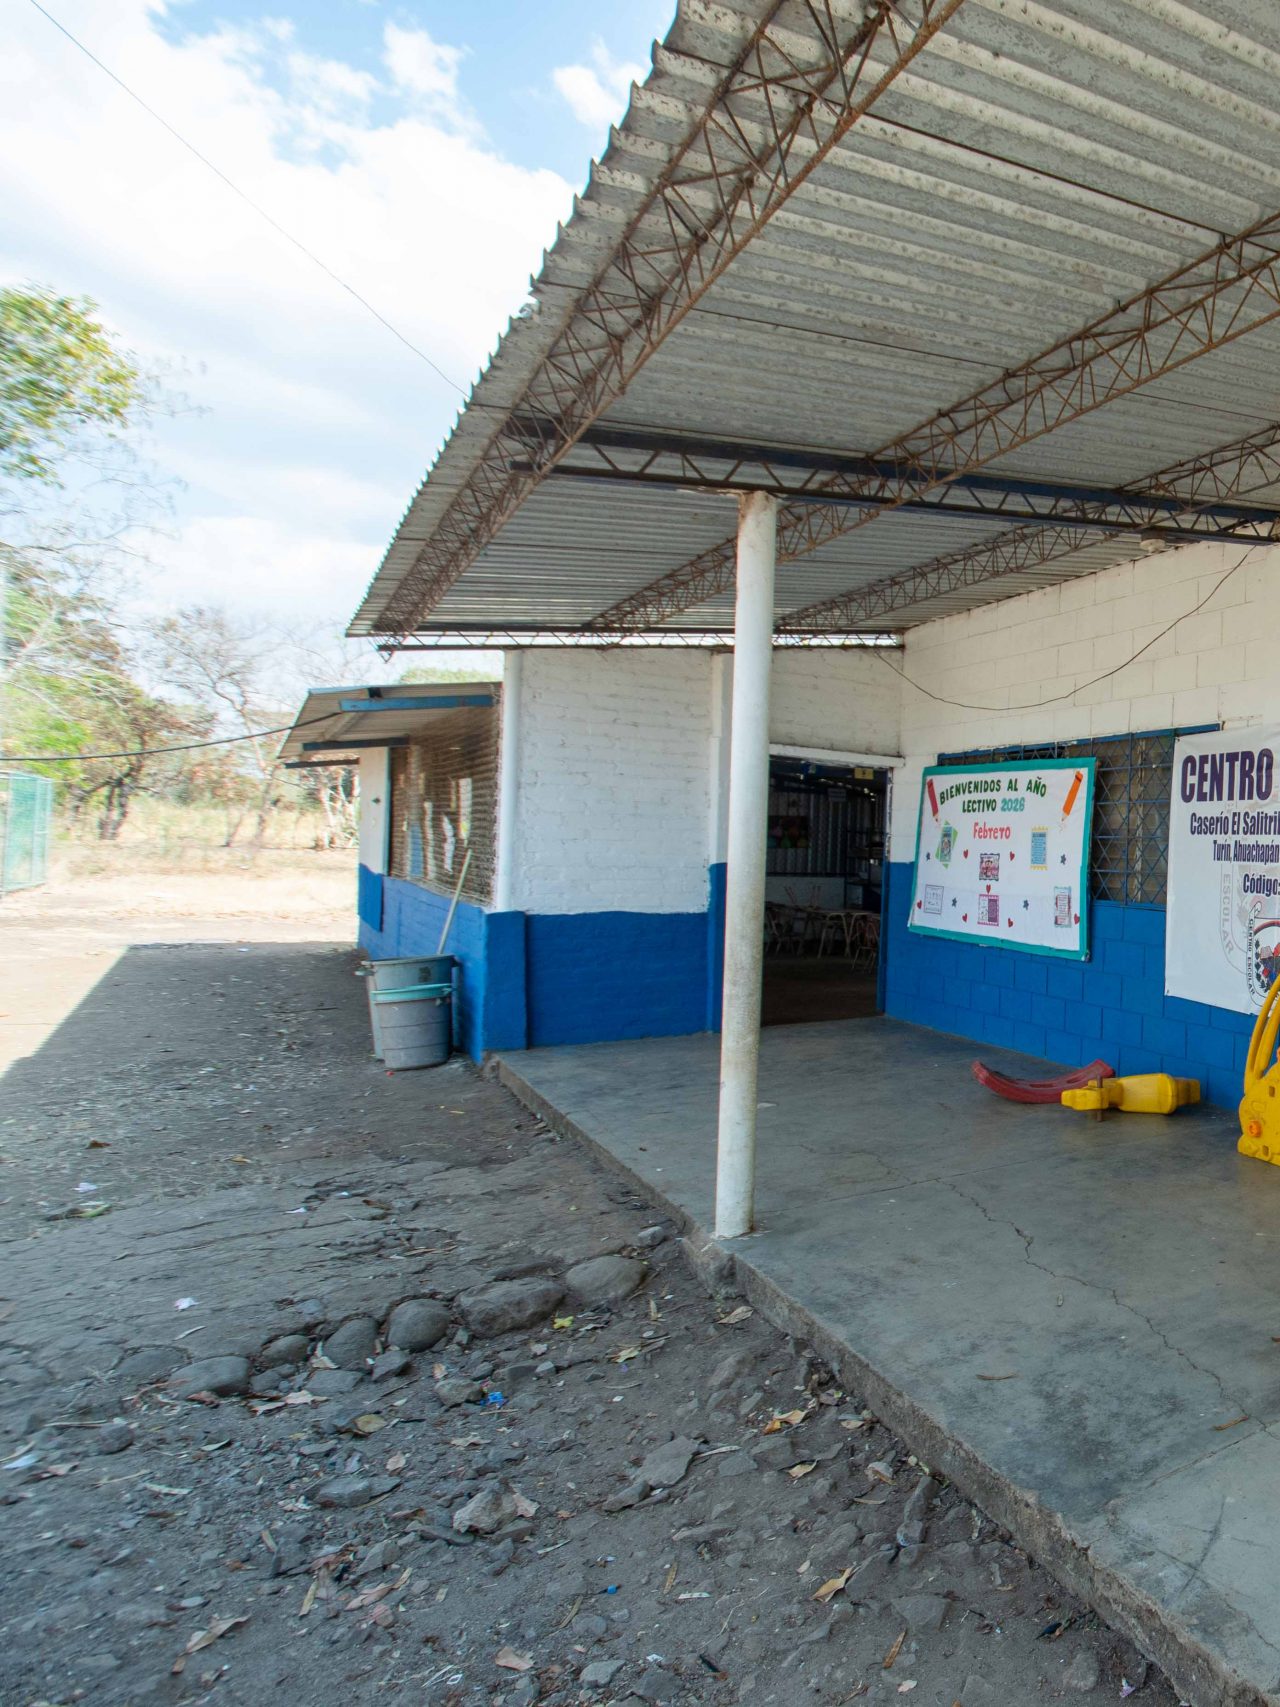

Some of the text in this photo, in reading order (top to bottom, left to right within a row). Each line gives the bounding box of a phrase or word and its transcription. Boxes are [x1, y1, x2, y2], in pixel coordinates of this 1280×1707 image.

[1181, 748, 1273, 803] CENTRO
[939, 776, 1047, 806] BIENVENIDOS AL AÑO
[961, 799, 997, 813] LECTIVO
[973, 822, 1011, 840] Febrero
[1189, 810, 1230, 836] Caserío
[1231, 812, 1241, 836] El
[1213, 839, 1232, 864] Turín,
[1233, 840, 1280, 865] Ahuachapán
[1243, 873, 1280, 898] Código:
[1222, 873, 1234, 954] ESCOLAR
